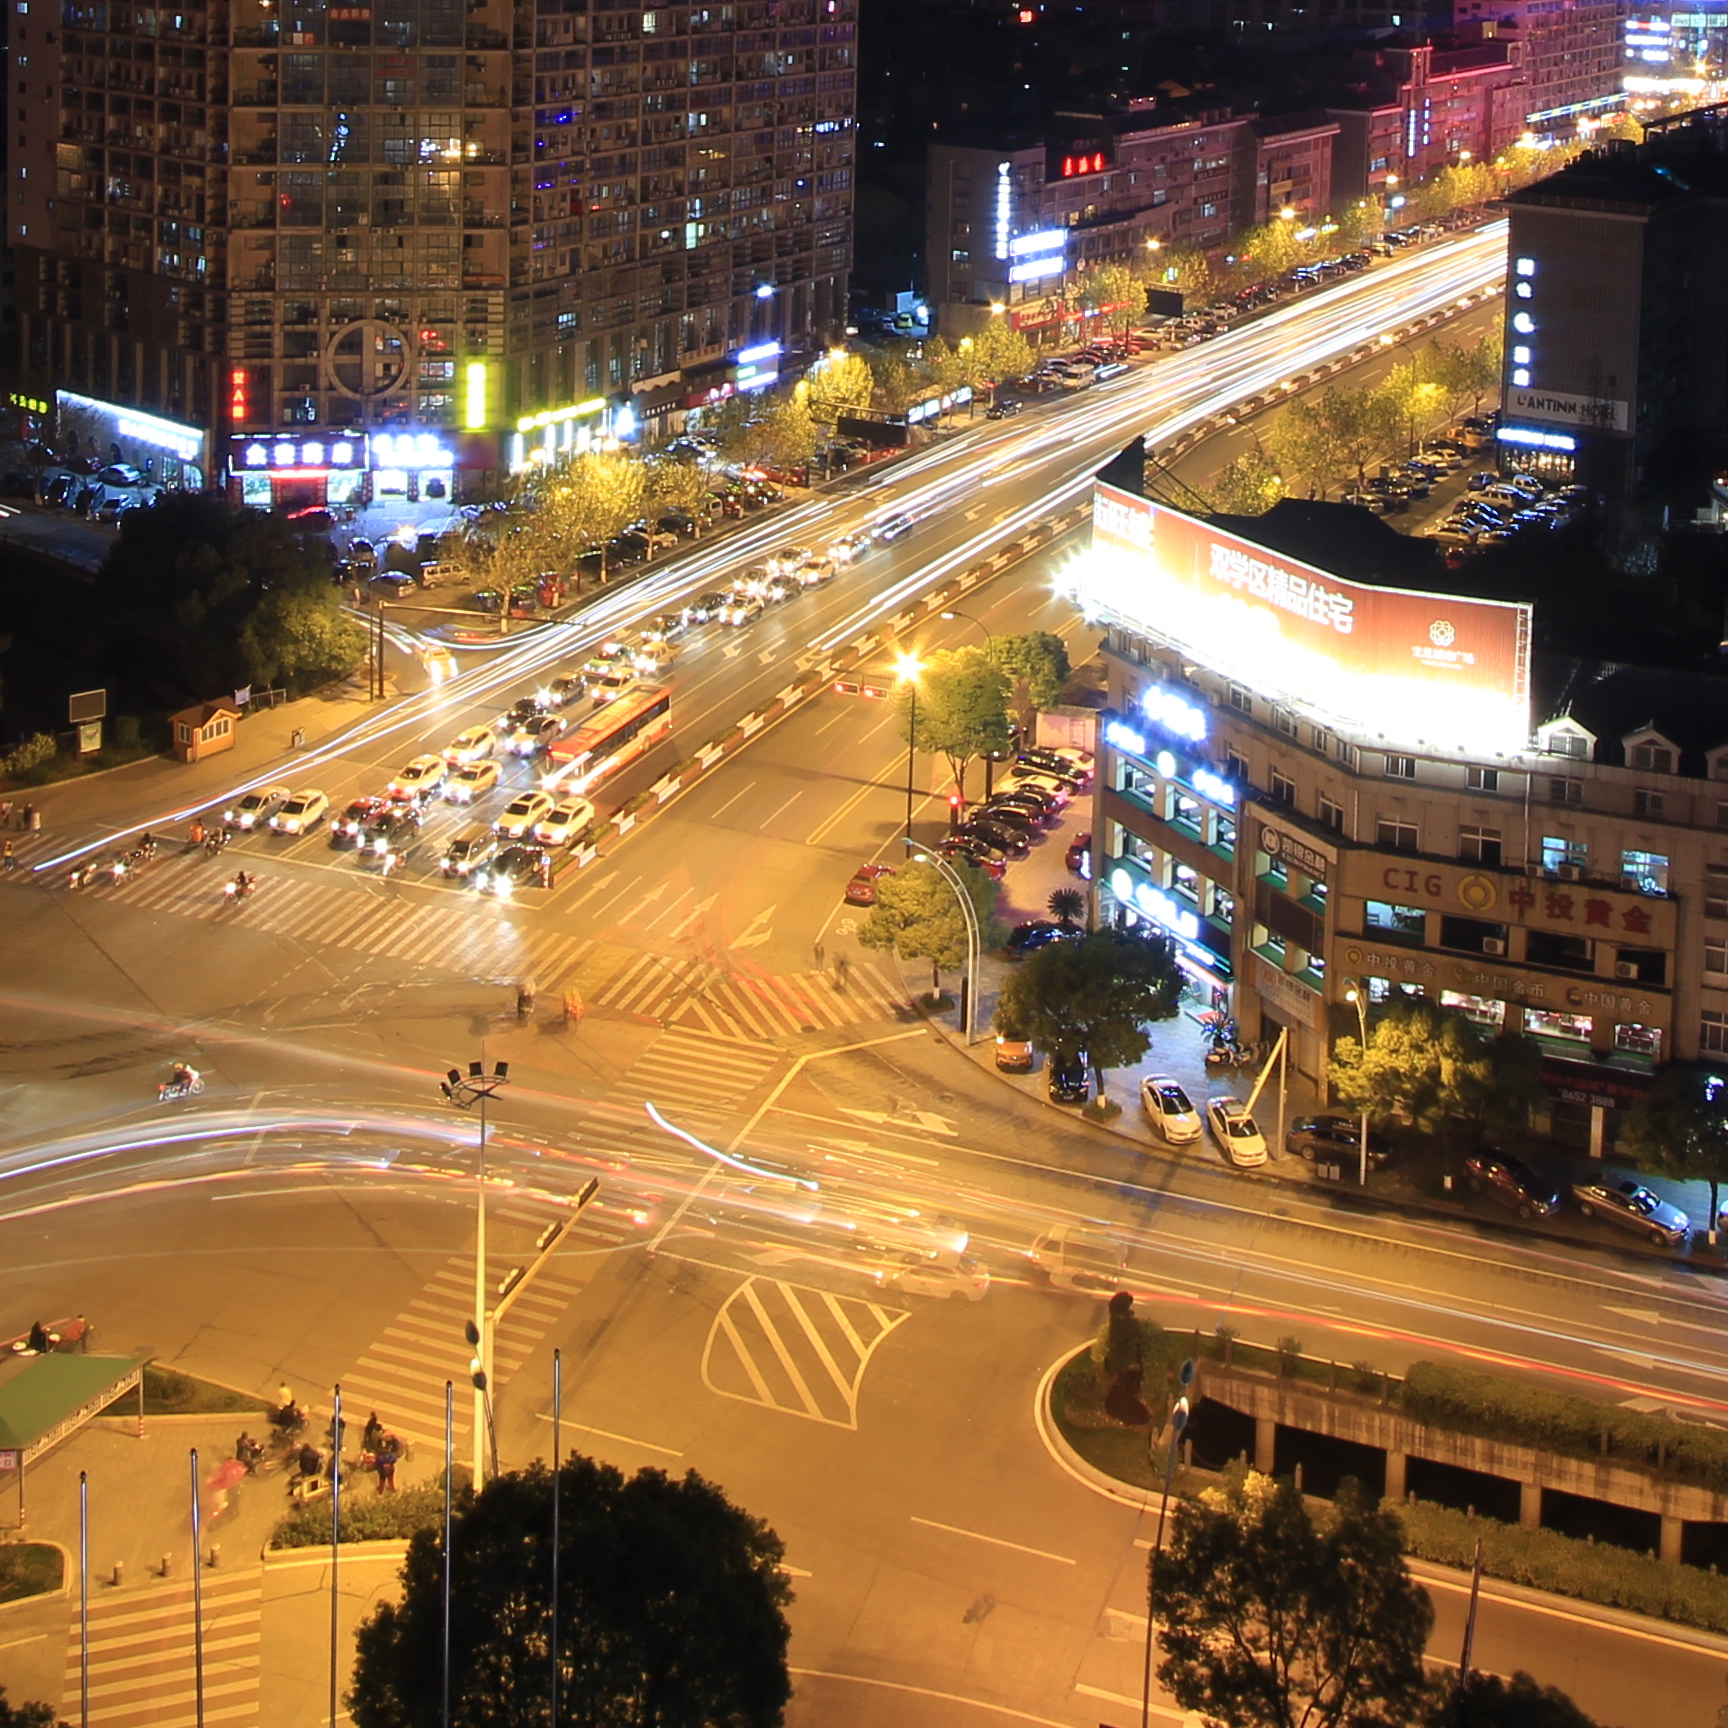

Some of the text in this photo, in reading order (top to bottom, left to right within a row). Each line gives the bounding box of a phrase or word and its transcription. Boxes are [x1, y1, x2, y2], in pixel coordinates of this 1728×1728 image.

[1517, 394, 1577, 415] L'ANTINN
[1209, 542, 1355, 634] 双学区精品住宅
[1383, 867, 1442, 897] CIG
[1508, 885, 1652, 934] 中投黄金
[1366, 952, 1436, 977] 中投黄金
[1475, 972, 1545, 998] 中国金币
[1584, 991, 1652, 1015] 中国黄金
